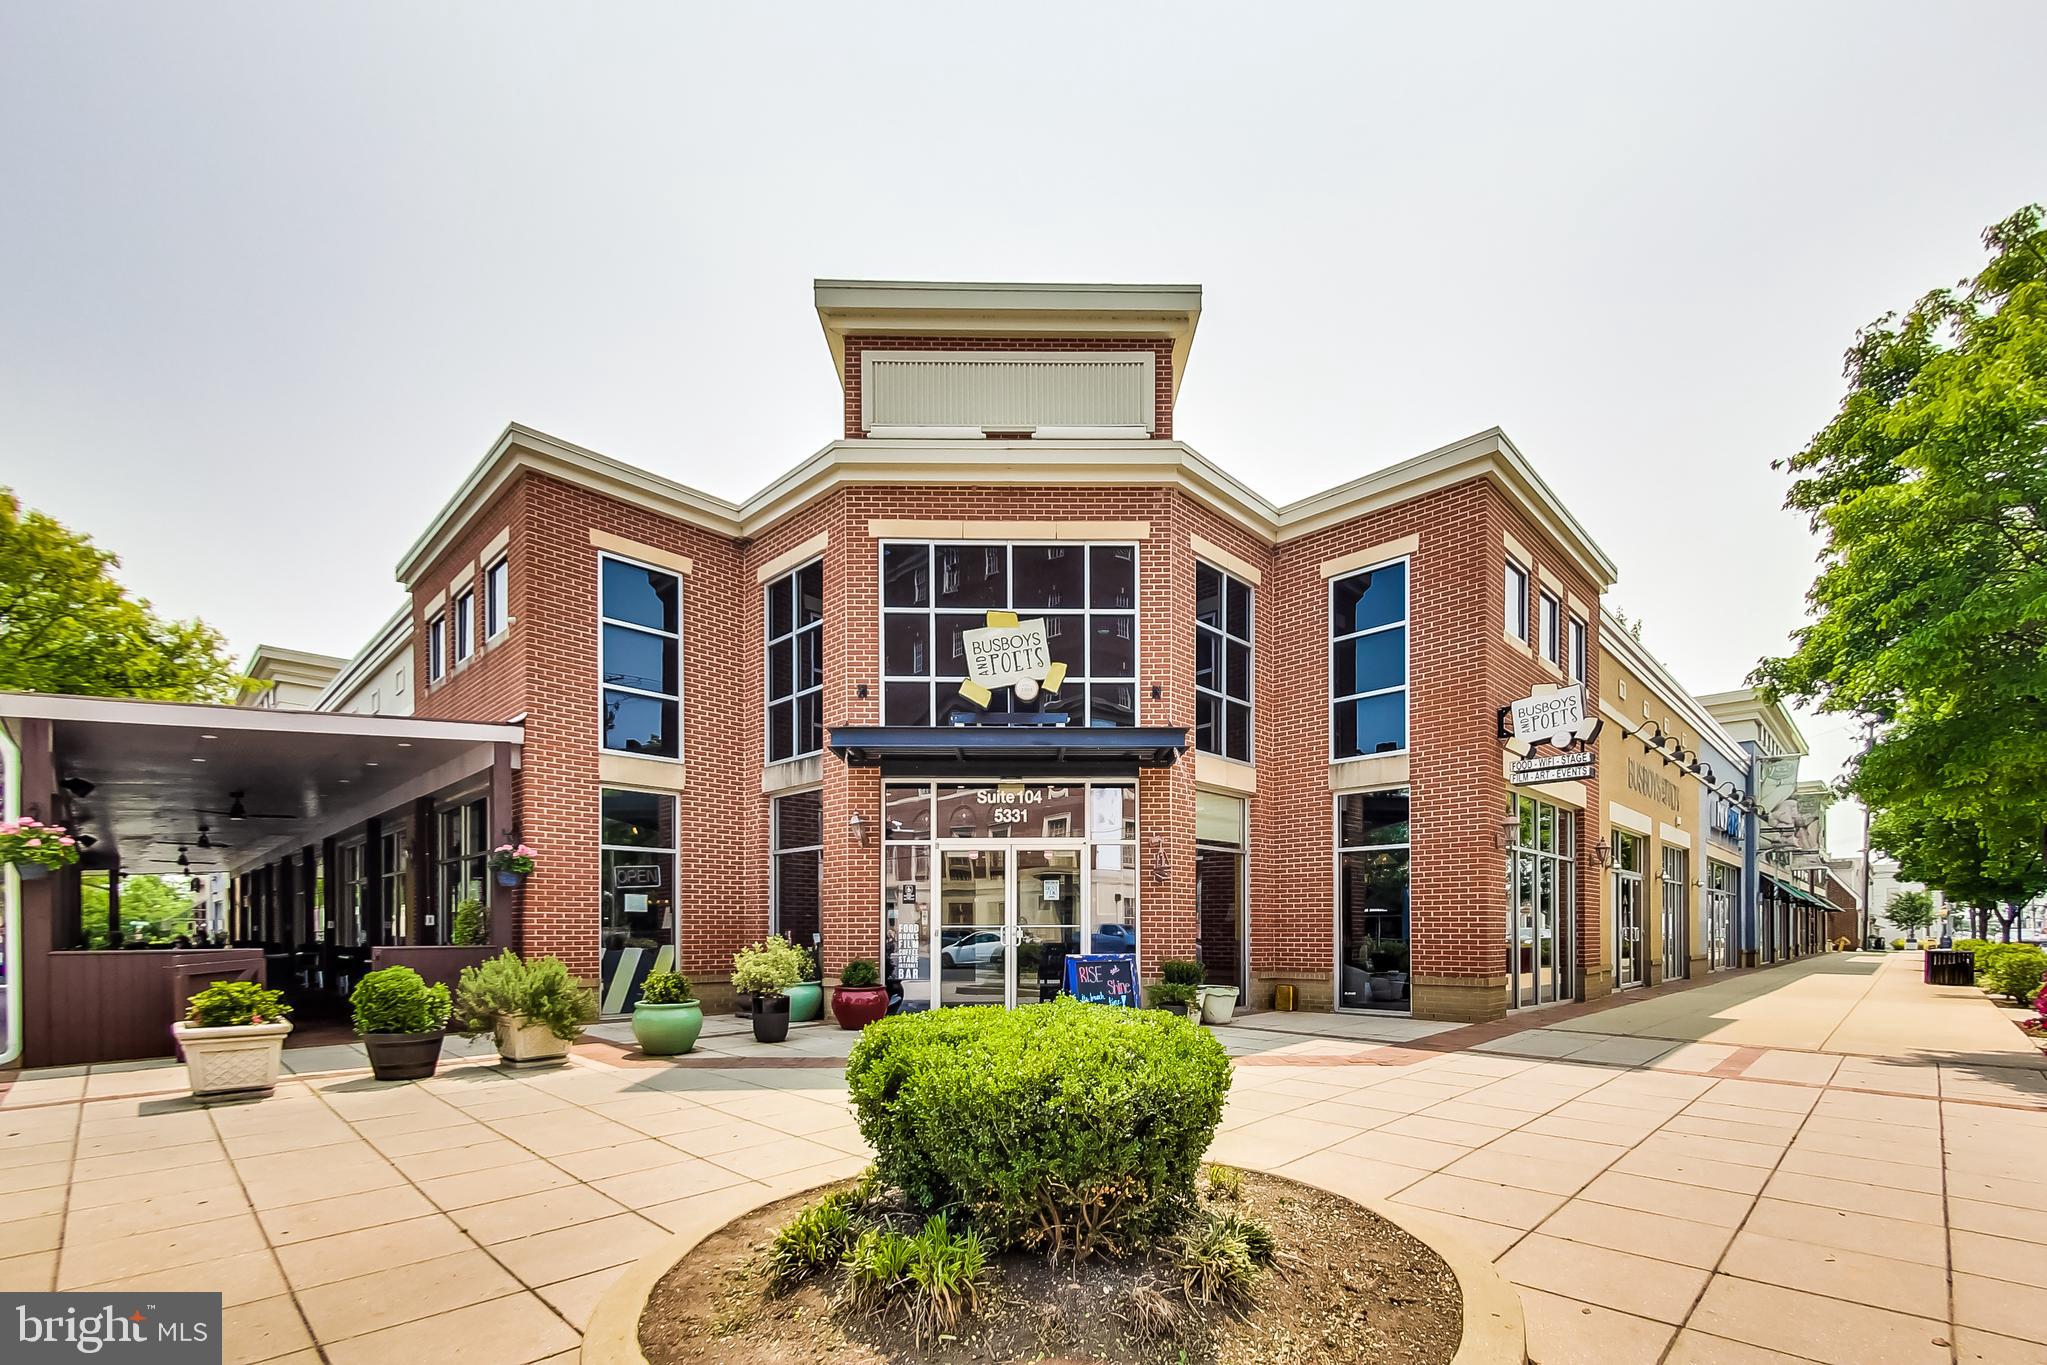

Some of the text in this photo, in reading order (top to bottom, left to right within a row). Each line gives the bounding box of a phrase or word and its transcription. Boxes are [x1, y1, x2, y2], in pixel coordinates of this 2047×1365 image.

[972, 632, 1041, 655] BUSBOYS
[976, 656, 989, 676] AND
[988, 647, 1044, 675] POETS
[1518, 696, 1577, 718] BUSBOYS
[1520, 719, 1530, 733] AND
[1531, 707, 1577, 732] POETS
[1512, 760, 1533, 771] FOOD
[1539, 757, 1555, 767] WIFI
[1561, 753, 1587, 765] STAGE
[1512, 773, 1529, 783] FILM
[1534, 771, 1550, 780] ART
[1556, 766, 1588, 778] EVENTS
[976, 789, 1043, 804] Suite 104
[993, 807, 1028, 823] 5331
[617, 869, 658, 884] OPEN
[898, 923, 919, 933] FOOD
[898, 940, 919, 949] FILM
[898, 968, 919, 980] BAR
[1078, 965, 1103, 983] RISE
[1107, 979, 1131, 995] Shine
